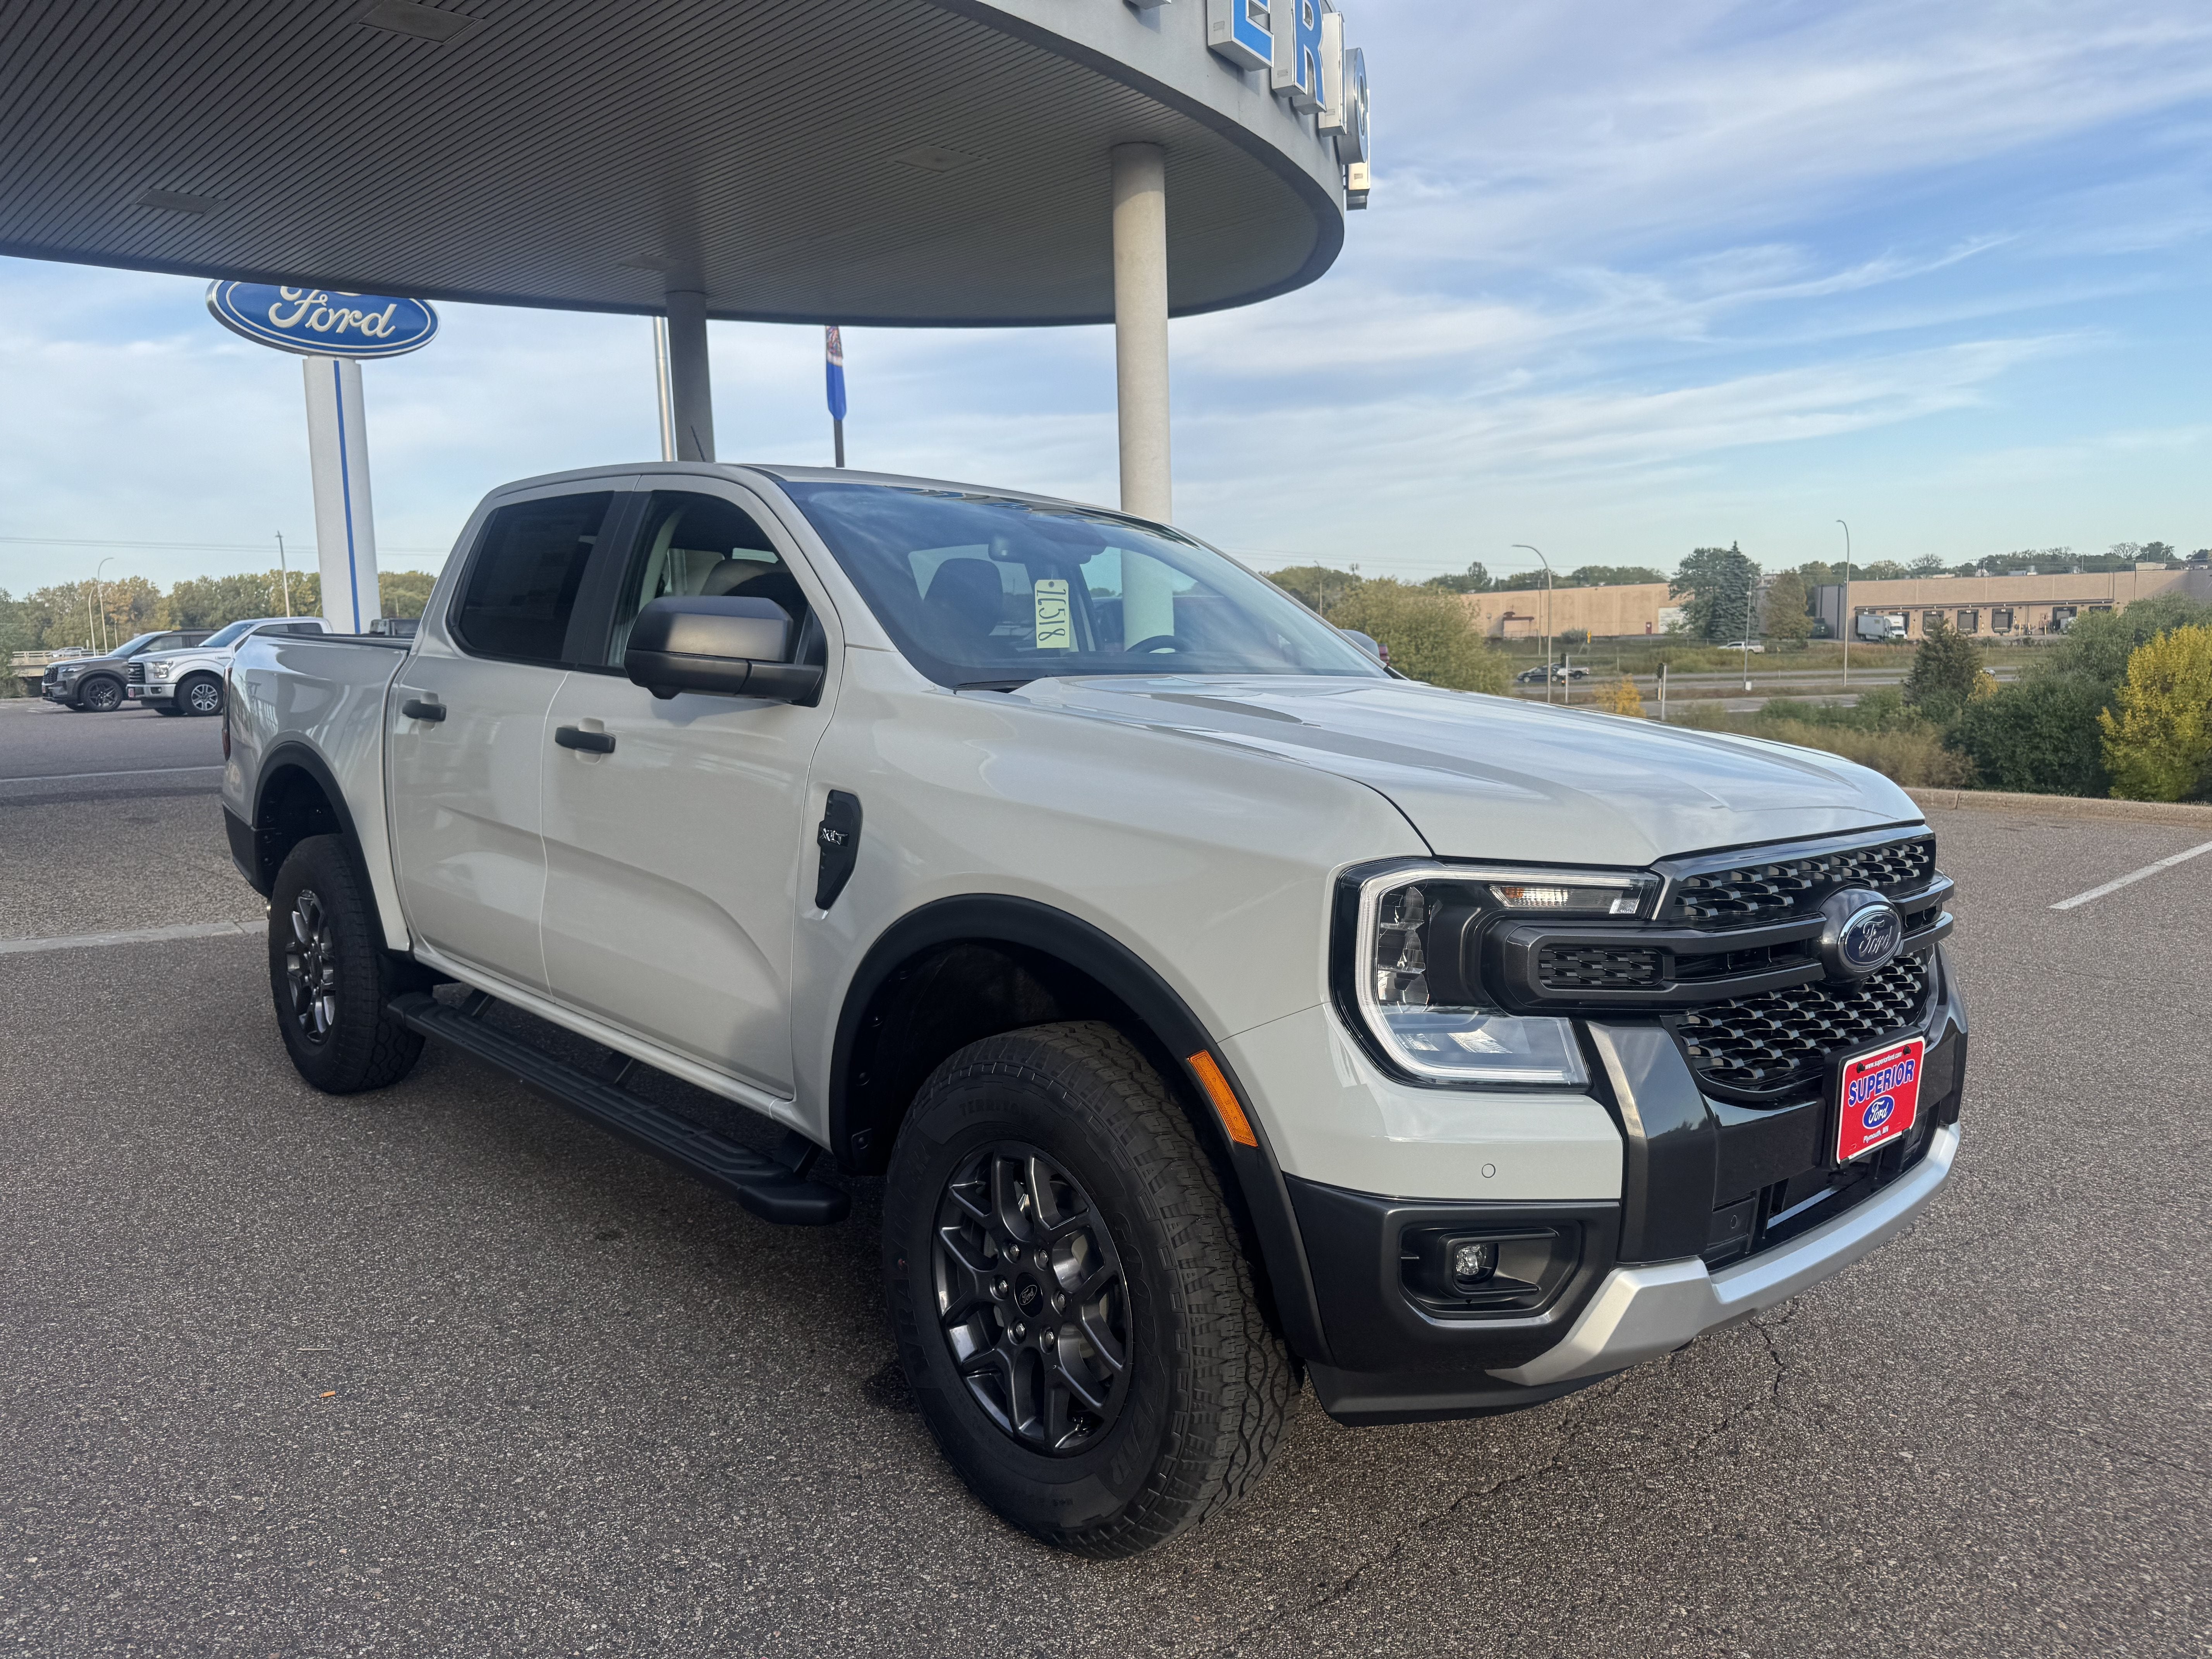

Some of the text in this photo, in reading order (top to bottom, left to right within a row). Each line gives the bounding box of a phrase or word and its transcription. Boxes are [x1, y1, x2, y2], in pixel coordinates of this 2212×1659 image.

[268, 285, 397, 338] Ford
[820, 828, 848, 845] XLT
[1858, 919, 1893, 958] Ford
[1848, 1058, 1916, 1107] SUPERIOR
[1868, 1100, 1889, 1124] Ford
[1022, 1288, 1034, 1304] Ford
